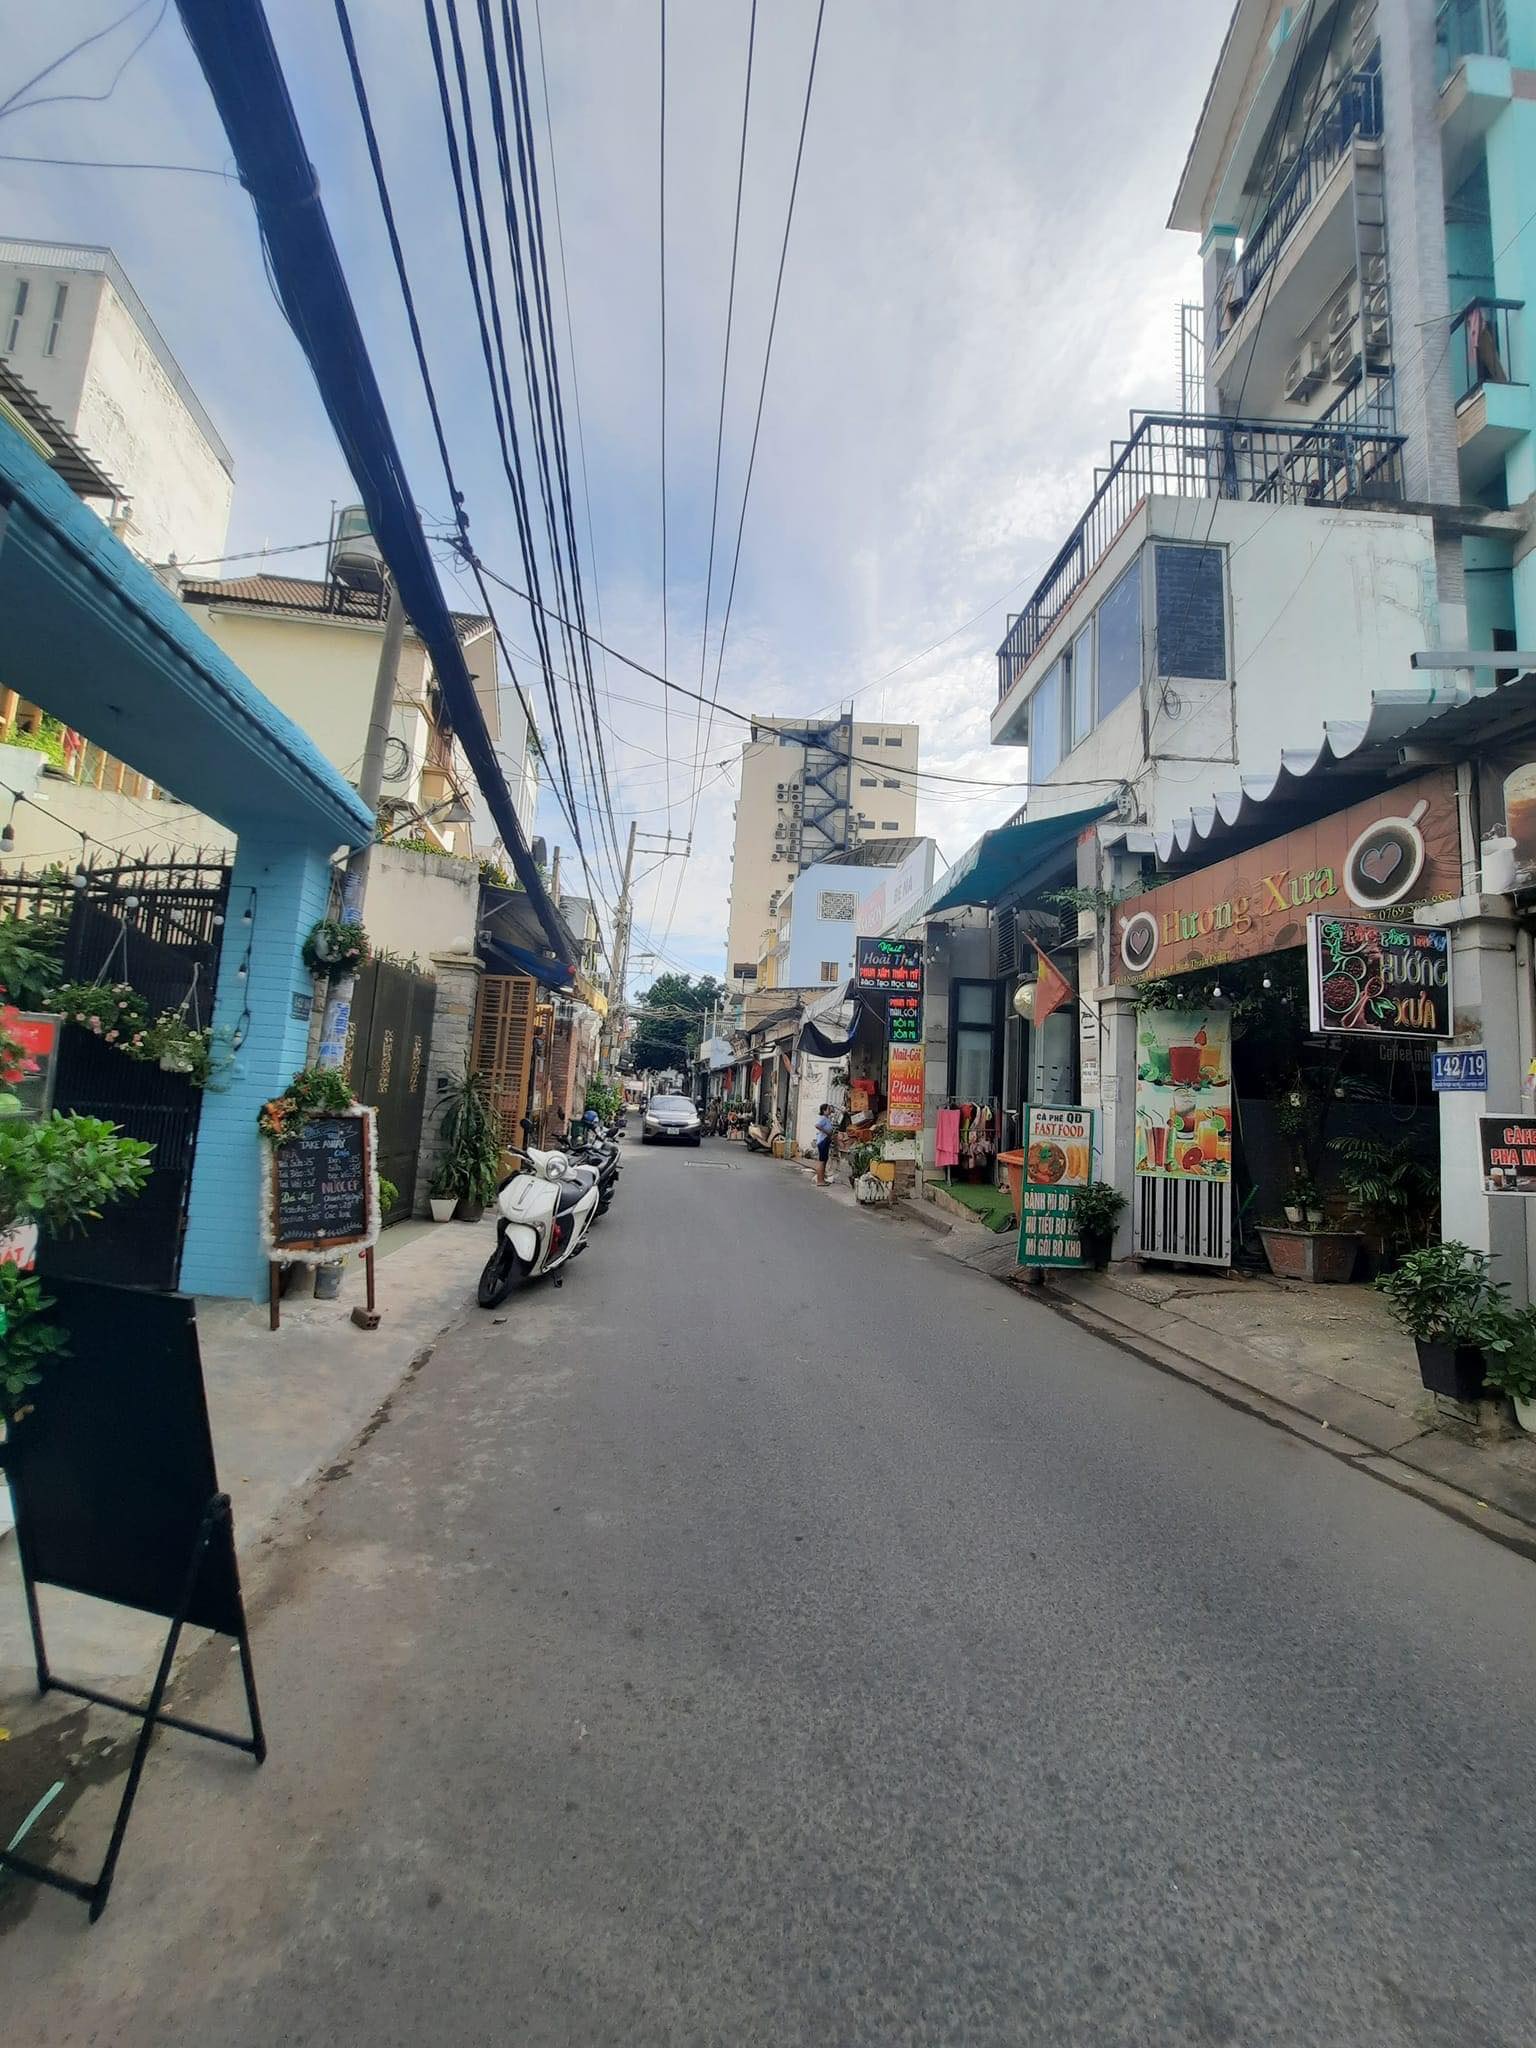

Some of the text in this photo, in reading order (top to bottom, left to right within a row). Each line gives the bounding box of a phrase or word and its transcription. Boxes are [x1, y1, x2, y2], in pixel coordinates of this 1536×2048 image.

[1378, 906, 1405, 921] 0769
[1435, 1055, 1485, 1079] 142/19
[891, 1080, 920, 1094] Phun
[1066, 1112, 1083, 1124] QD
[1034, 1122, 1084, 1137] FAST FOOD
[1064, 1240, 1081, 1258] KHO
